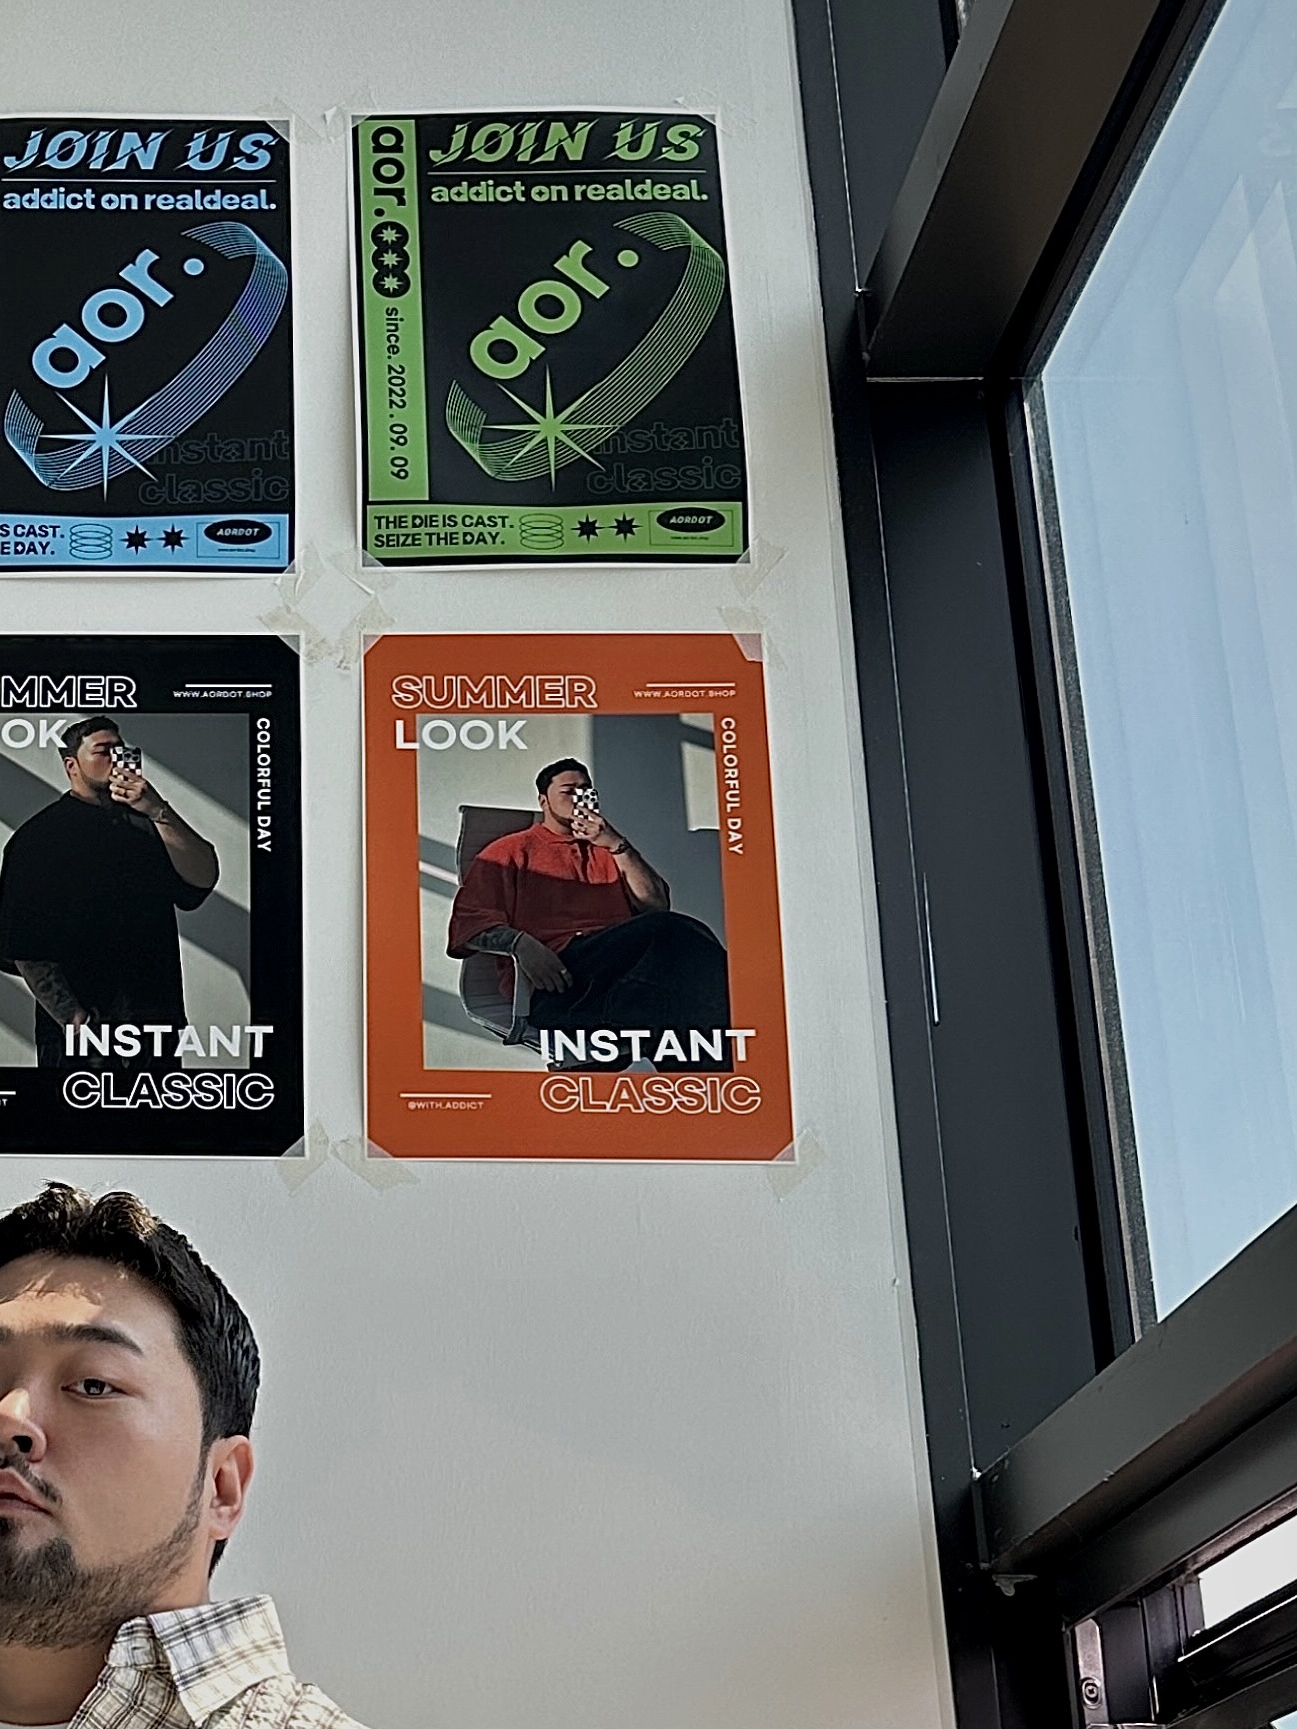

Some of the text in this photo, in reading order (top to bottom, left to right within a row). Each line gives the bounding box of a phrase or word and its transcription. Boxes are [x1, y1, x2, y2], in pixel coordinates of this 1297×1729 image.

[3, 129, 279, 172] JOIN US
[428, 120, 706, 166] JOIN US
[3, 187, 277, 211] addict on realdeal.
[431, 179, 709, 202] addict on realdeal.
[385, 306, 405, 360] since.
[138, 467, 290, 506] classic
[586, 455, 742, 494] classic
[13, 524, 65, 539] CAST.
[373, 514, 515, 530] THE DIE IS CAST.
[373, 531, 505, 548] SEIZE THE DAY.
[13, 541, 55, 556] DAY.
[391, 674, 598, 710] SUMMER
[395, 719, 528, 750] LOOK
[255, 717, 273, 853] COLORFUL DAY
[721, 717, 744, 856] COLORFUL DAY
[65, 1023, 274, 1058] INSTANT
[539, 1028, 757, 1063] INSTANT
[62, 1071, 275, 1110] CLASSIC
[539, 1075, 762, 1115] CLASSIC
